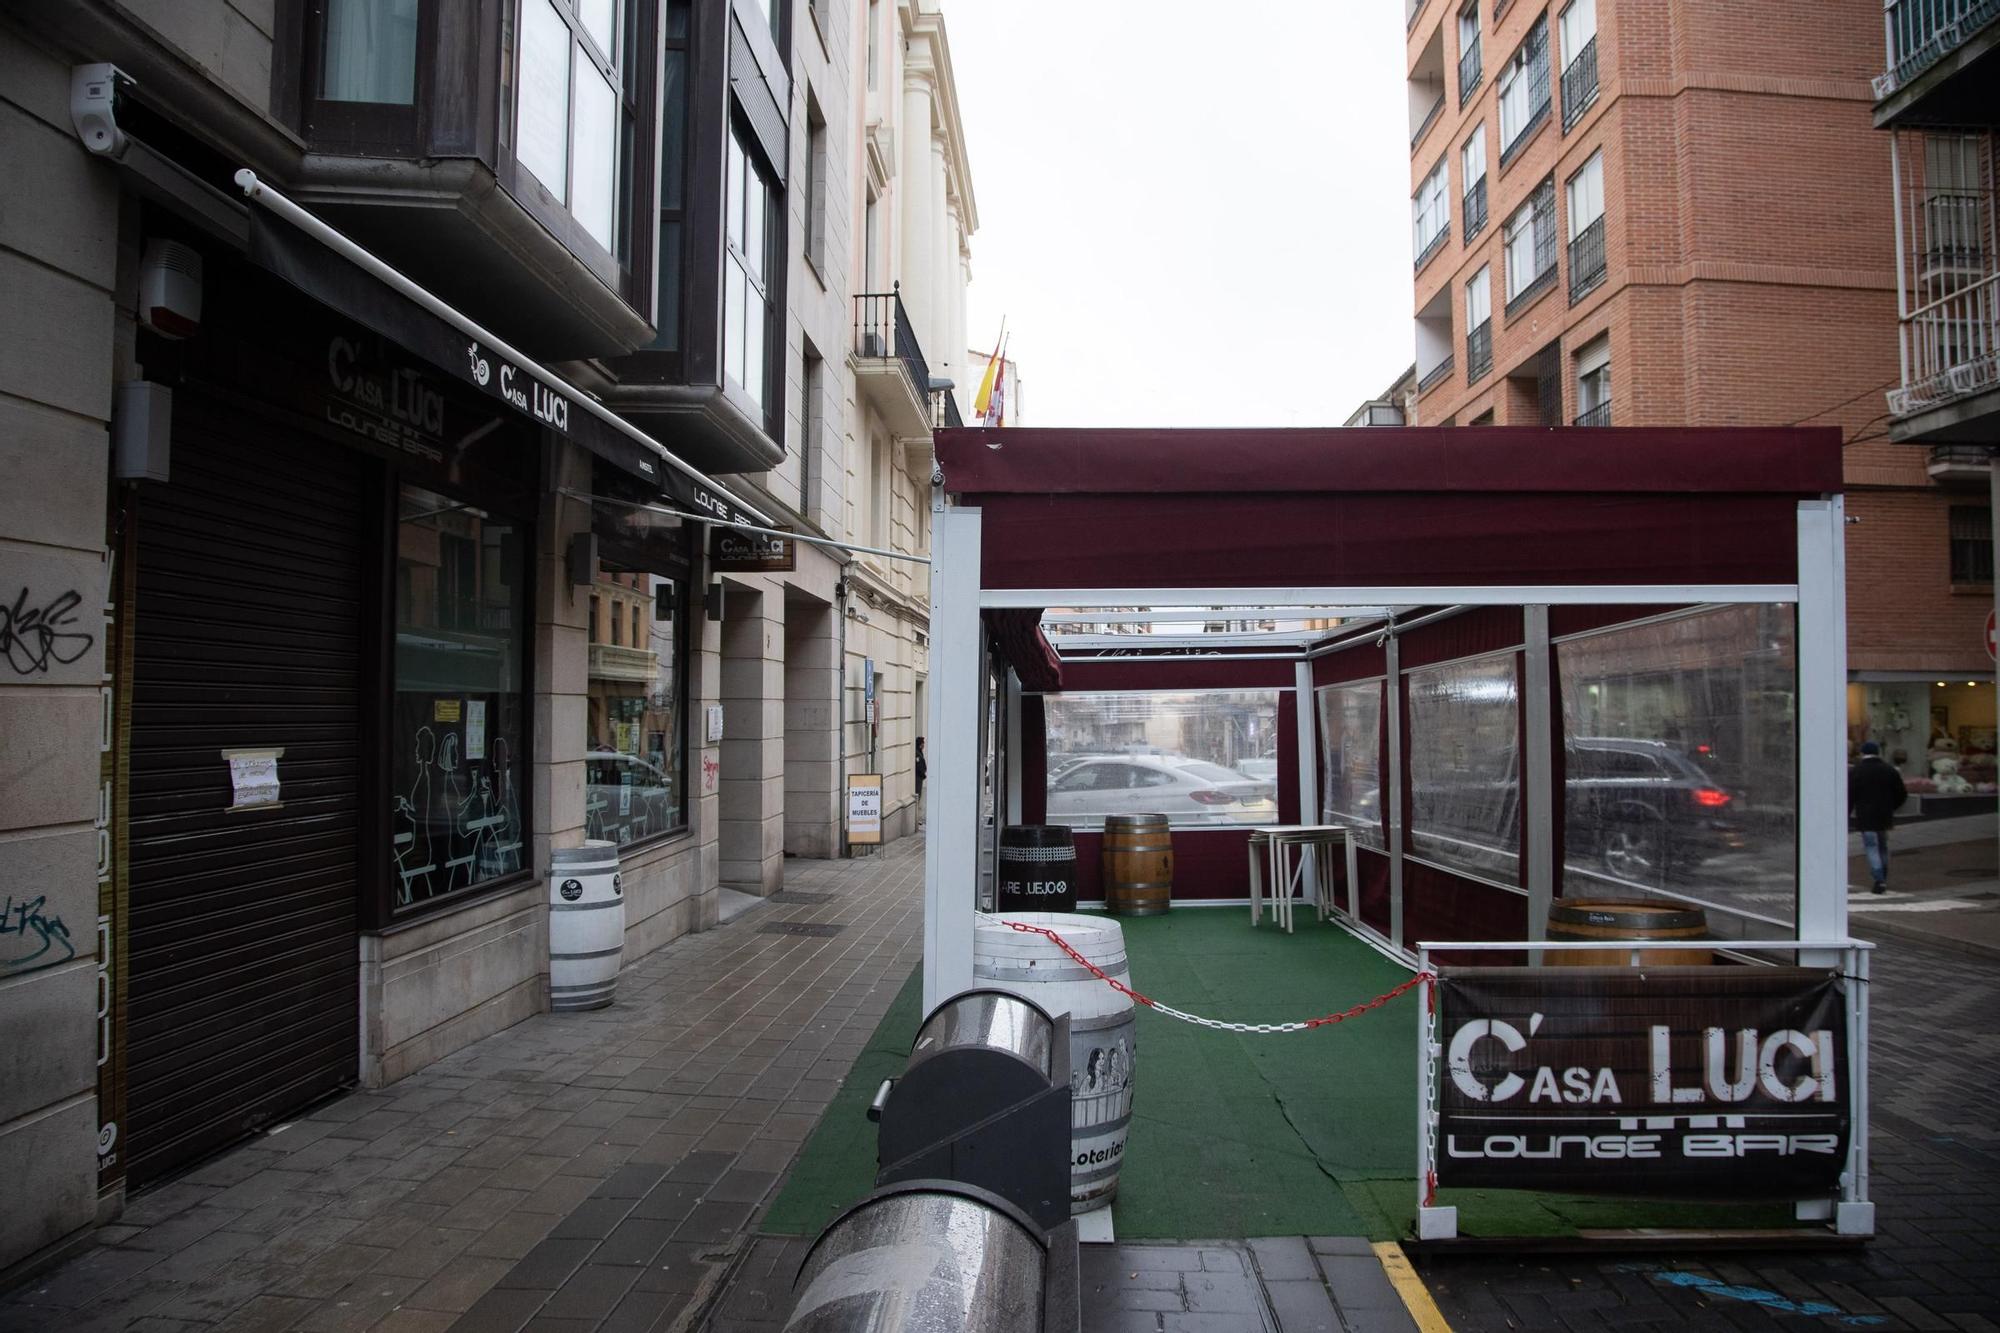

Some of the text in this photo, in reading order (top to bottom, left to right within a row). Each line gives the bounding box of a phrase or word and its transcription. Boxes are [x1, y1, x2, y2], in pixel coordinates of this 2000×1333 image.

[391, 367, 444, 437] LUCI
[533, 382, 569, 432] LUCI
[327, 405, 444, 464] LOUNGE BAR
[693, 487, 728, 519] LOUNGE
[1648, 1025, 1835, 1103] LUCI
[1071, 1140, 1124, 1165] oterias
[1447, 1134, 1838, 1159] LOUNGE BAR
